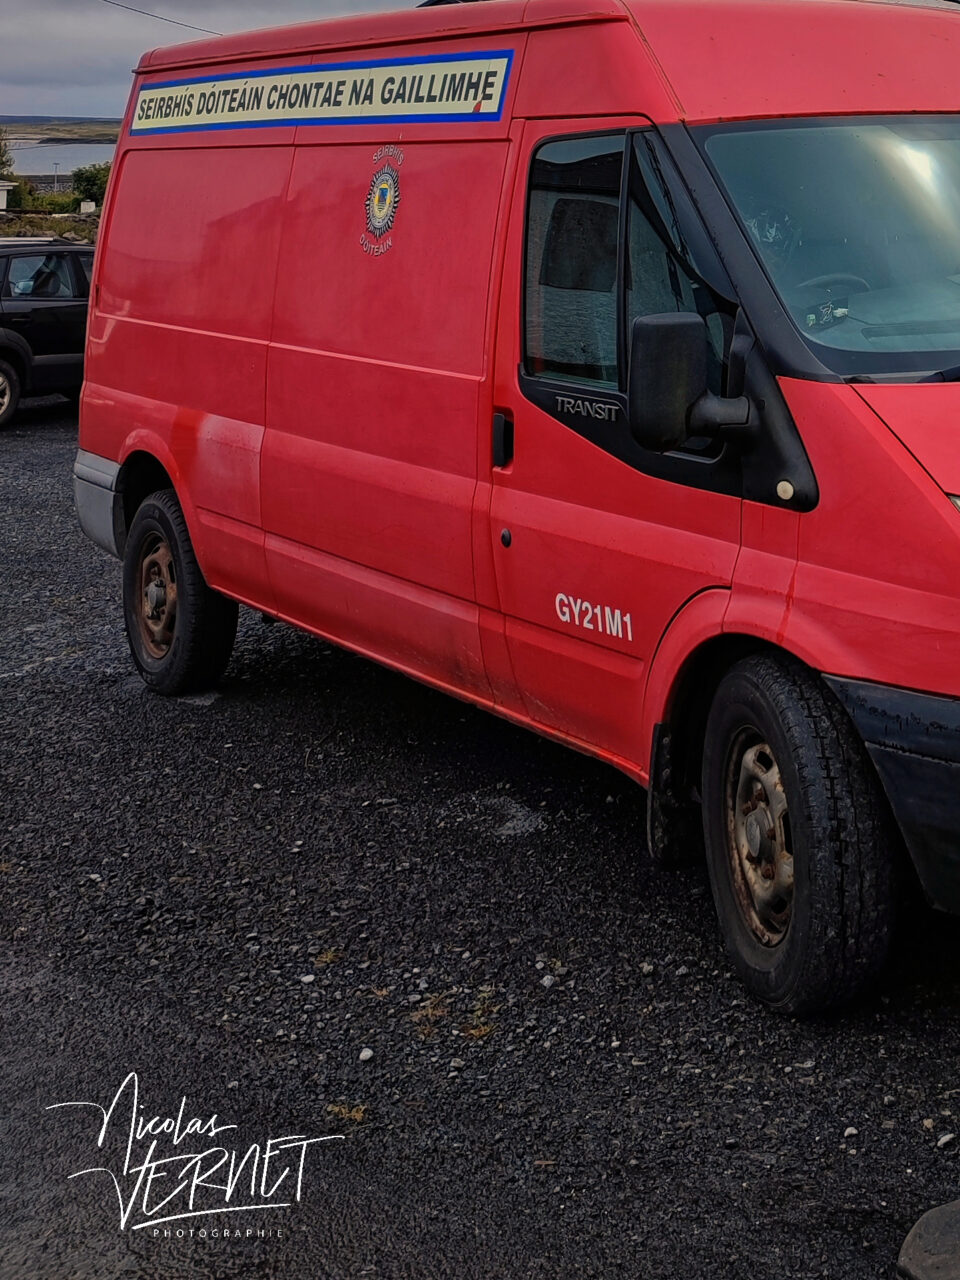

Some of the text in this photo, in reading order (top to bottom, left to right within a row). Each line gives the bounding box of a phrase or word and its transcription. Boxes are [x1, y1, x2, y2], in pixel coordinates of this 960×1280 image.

[138, 70, 498, 121] SEIRBHÍS DÓITEÁIN CHONTAE NA GAILLIMHE
[555, 396, 620, 422] TRANSIT
[555, 592, 633, 642] GY21M1
